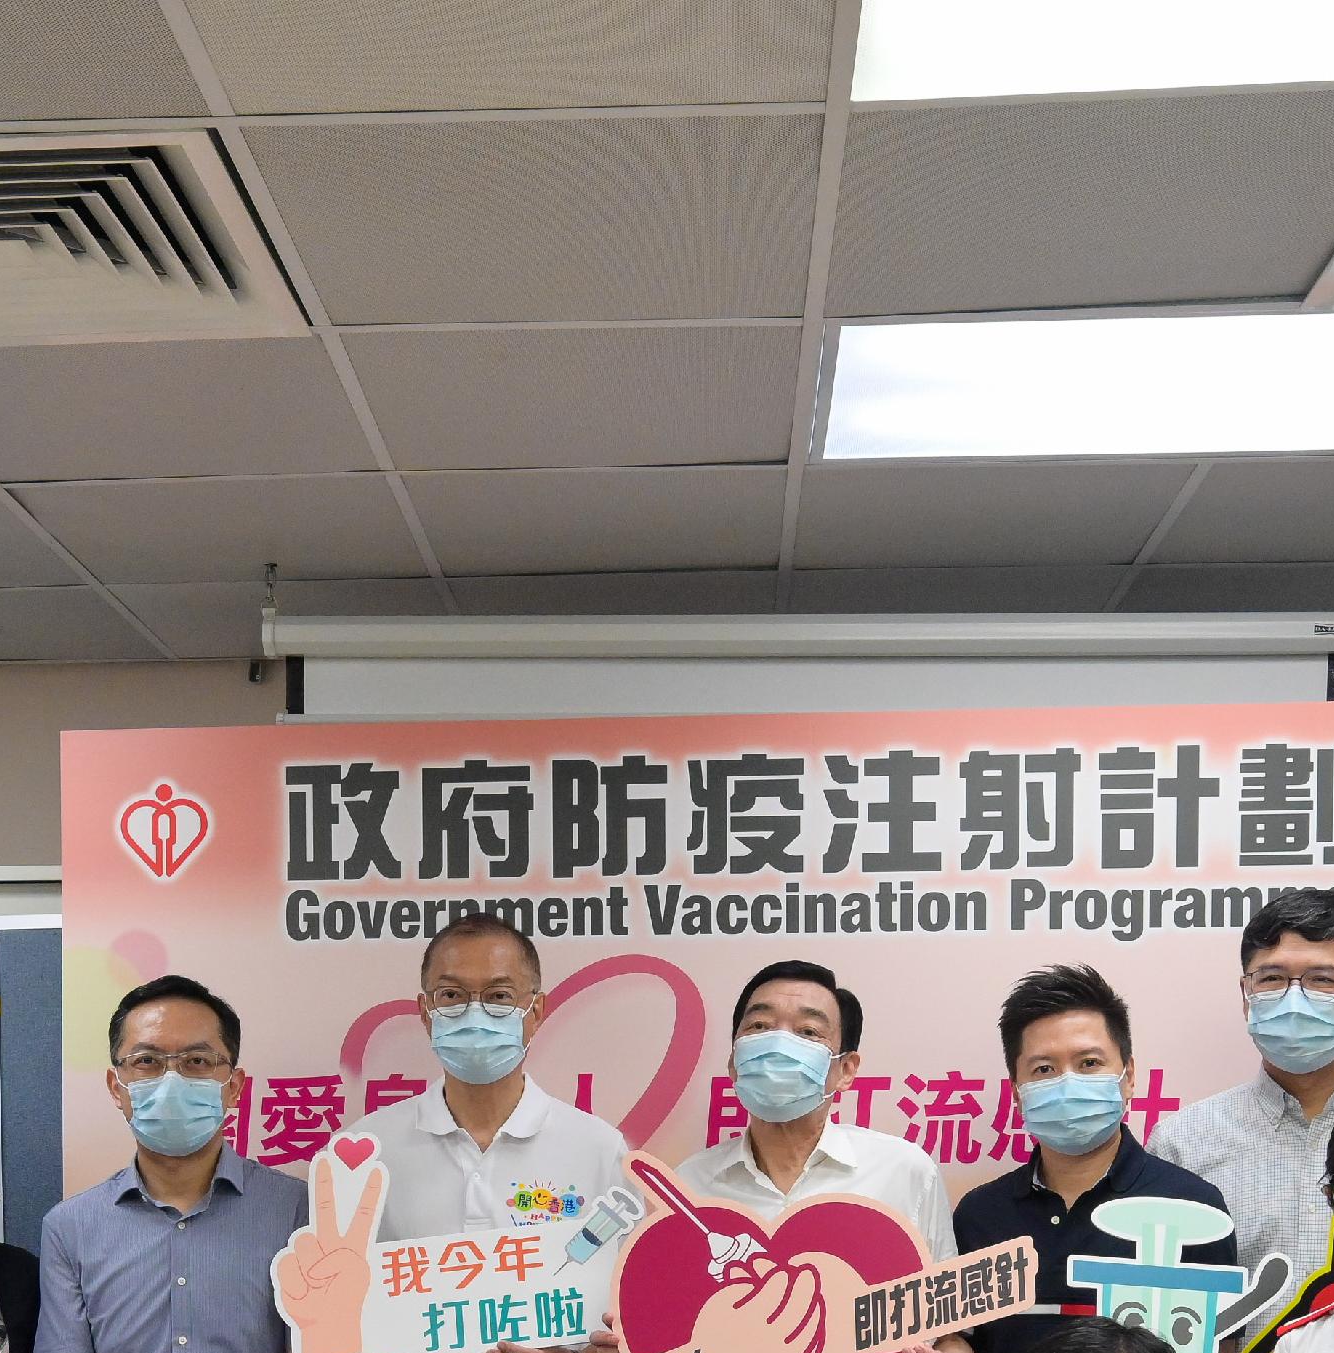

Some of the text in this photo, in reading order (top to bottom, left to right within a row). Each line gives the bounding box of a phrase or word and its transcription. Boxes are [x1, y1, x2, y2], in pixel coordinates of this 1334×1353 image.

[645, 877, 986, 937] Vaccination
[381, 1235, 544, 1297] 我今年
[421, 1287, 587, 1352] 打咗啦
[854, 1246, 1029, 1351] 即打流感針
